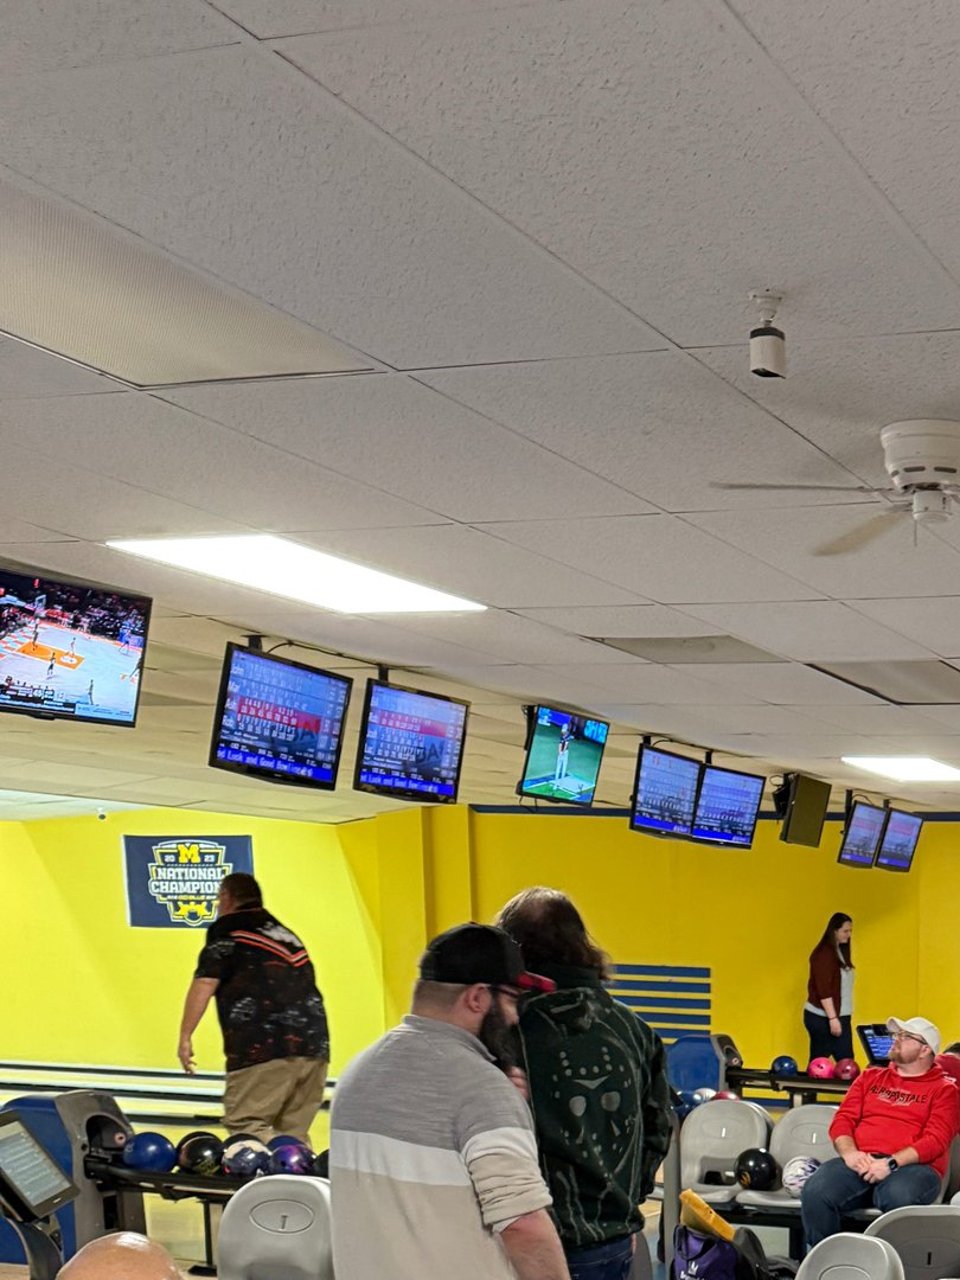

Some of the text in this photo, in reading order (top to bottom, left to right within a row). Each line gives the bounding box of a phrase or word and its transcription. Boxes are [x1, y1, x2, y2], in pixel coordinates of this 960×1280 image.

[177, 844, 201, 863] M
[157, 867, 224, 880] NATIONAL
[151, 881, 222, 894] CHAMPION
